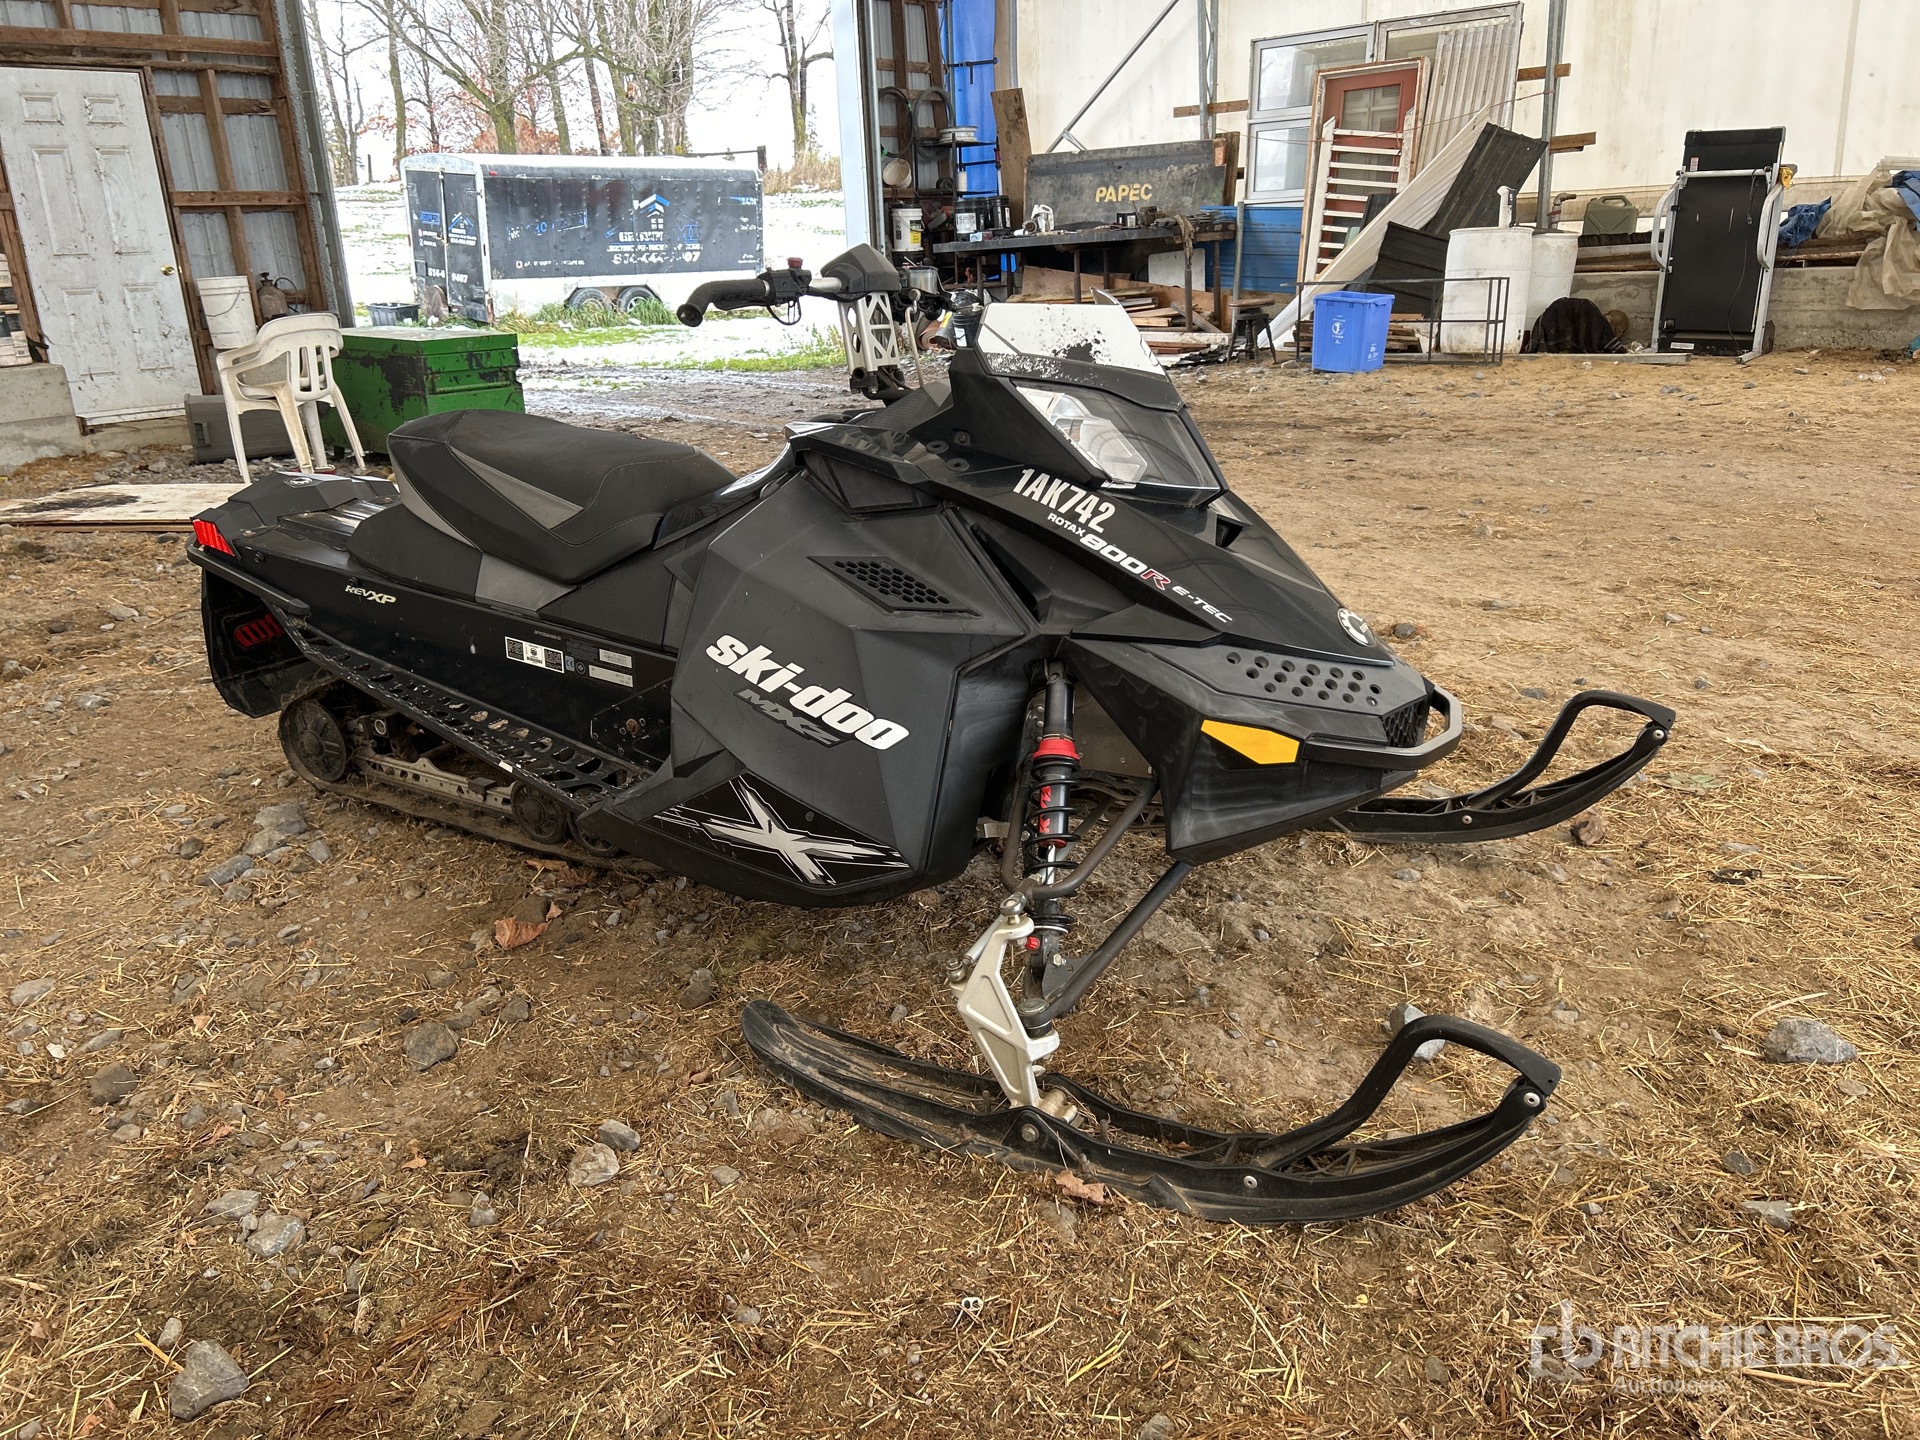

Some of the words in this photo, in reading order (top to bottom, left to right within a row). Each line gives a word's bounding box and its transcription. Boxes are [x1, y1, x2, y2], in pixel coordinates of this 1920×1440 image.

[1095, 183, 1152, 203] PAPEC
[1012, 468, 1116, 534] 1AK742
[1047, 512, 1086, 537] ROTAX
[1172, 585, 1233, 623] E-TEC
[705, 635, 910, 750] ski-doo
